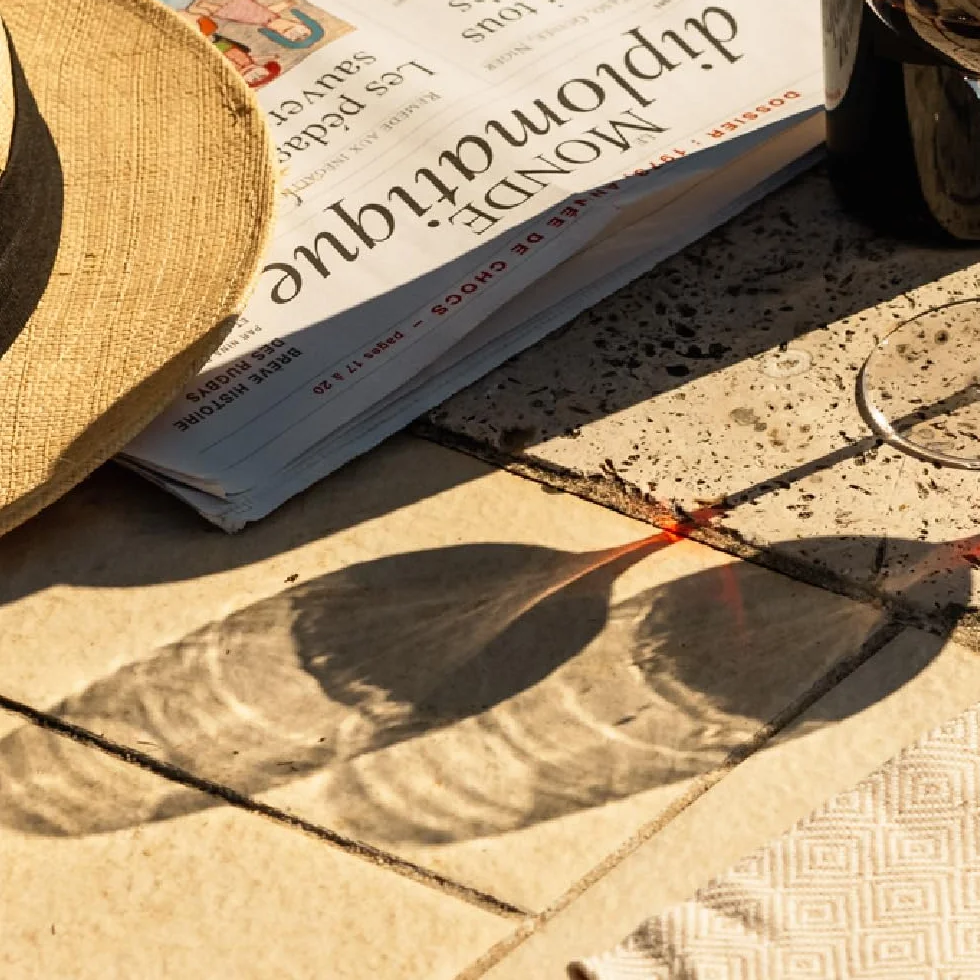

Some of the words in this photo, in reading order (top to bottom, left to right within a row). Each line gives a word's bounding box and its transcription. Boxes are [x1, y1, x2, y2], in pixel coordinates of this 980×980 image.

[461, 1, 538, 44] tous
[268, 53, 376, 126] sauver
[365, 59, 435, 98] Les
[706, 90, 801, 139] DOSSIER
[262, 5, 744, 304] diplomatique
[447, 108, 671, 236] MONDE
[509, 232, 545, 256] DE
[429, 260, 508, 316] CHOCS
[250, 338, 285, 360] DES
[363, 330, 405, 359] pages
[185, 359, 252, 403] RUGBYS
[312, 379, 333, 395] 20
[346, 359, 363, 374] 17
[172, 384, 250, 432] HISTOIRE
